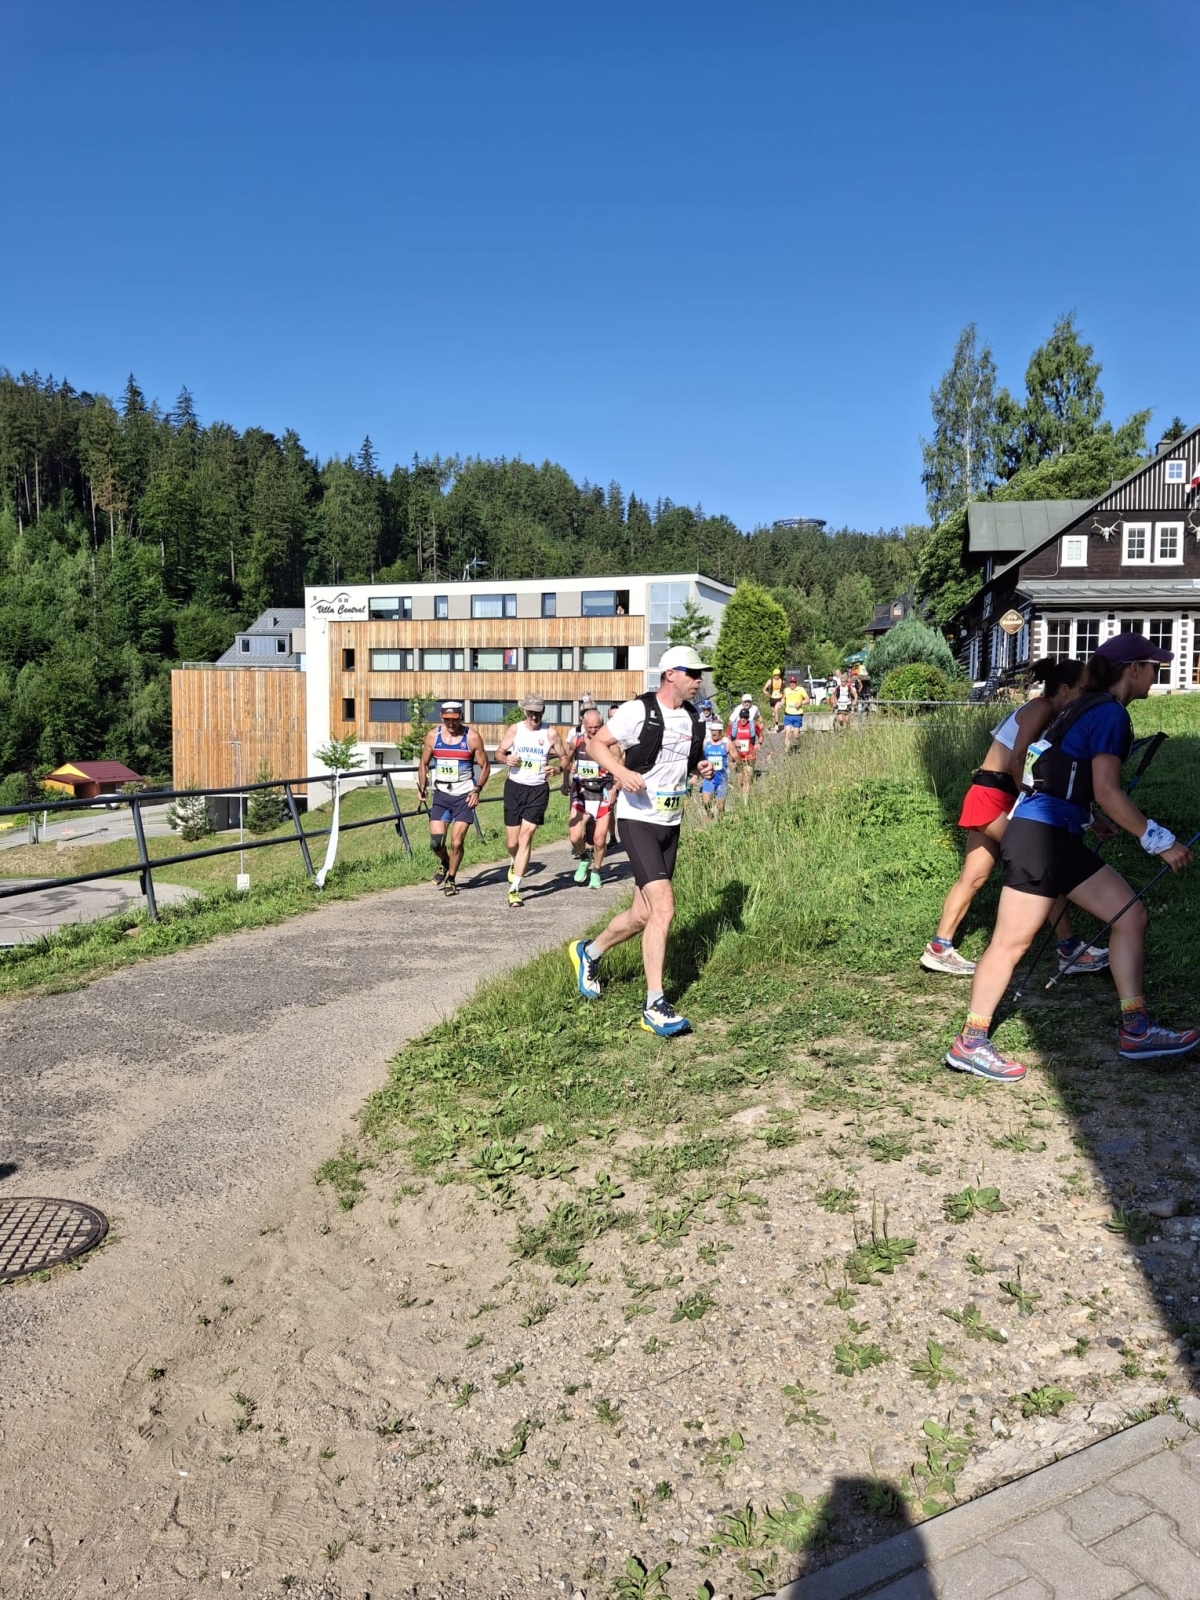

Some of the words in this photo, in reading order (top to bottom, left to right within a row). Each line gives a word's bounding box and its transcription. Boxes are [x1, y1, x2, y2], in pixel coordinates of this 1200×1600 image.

[316, 605, 335, 614] Villa
[337, 604, 366, 615] Central
[524, 760, 533, 768] 76
[582, 767, 594, 775] 594
[664, 796, 680, 808] 471
